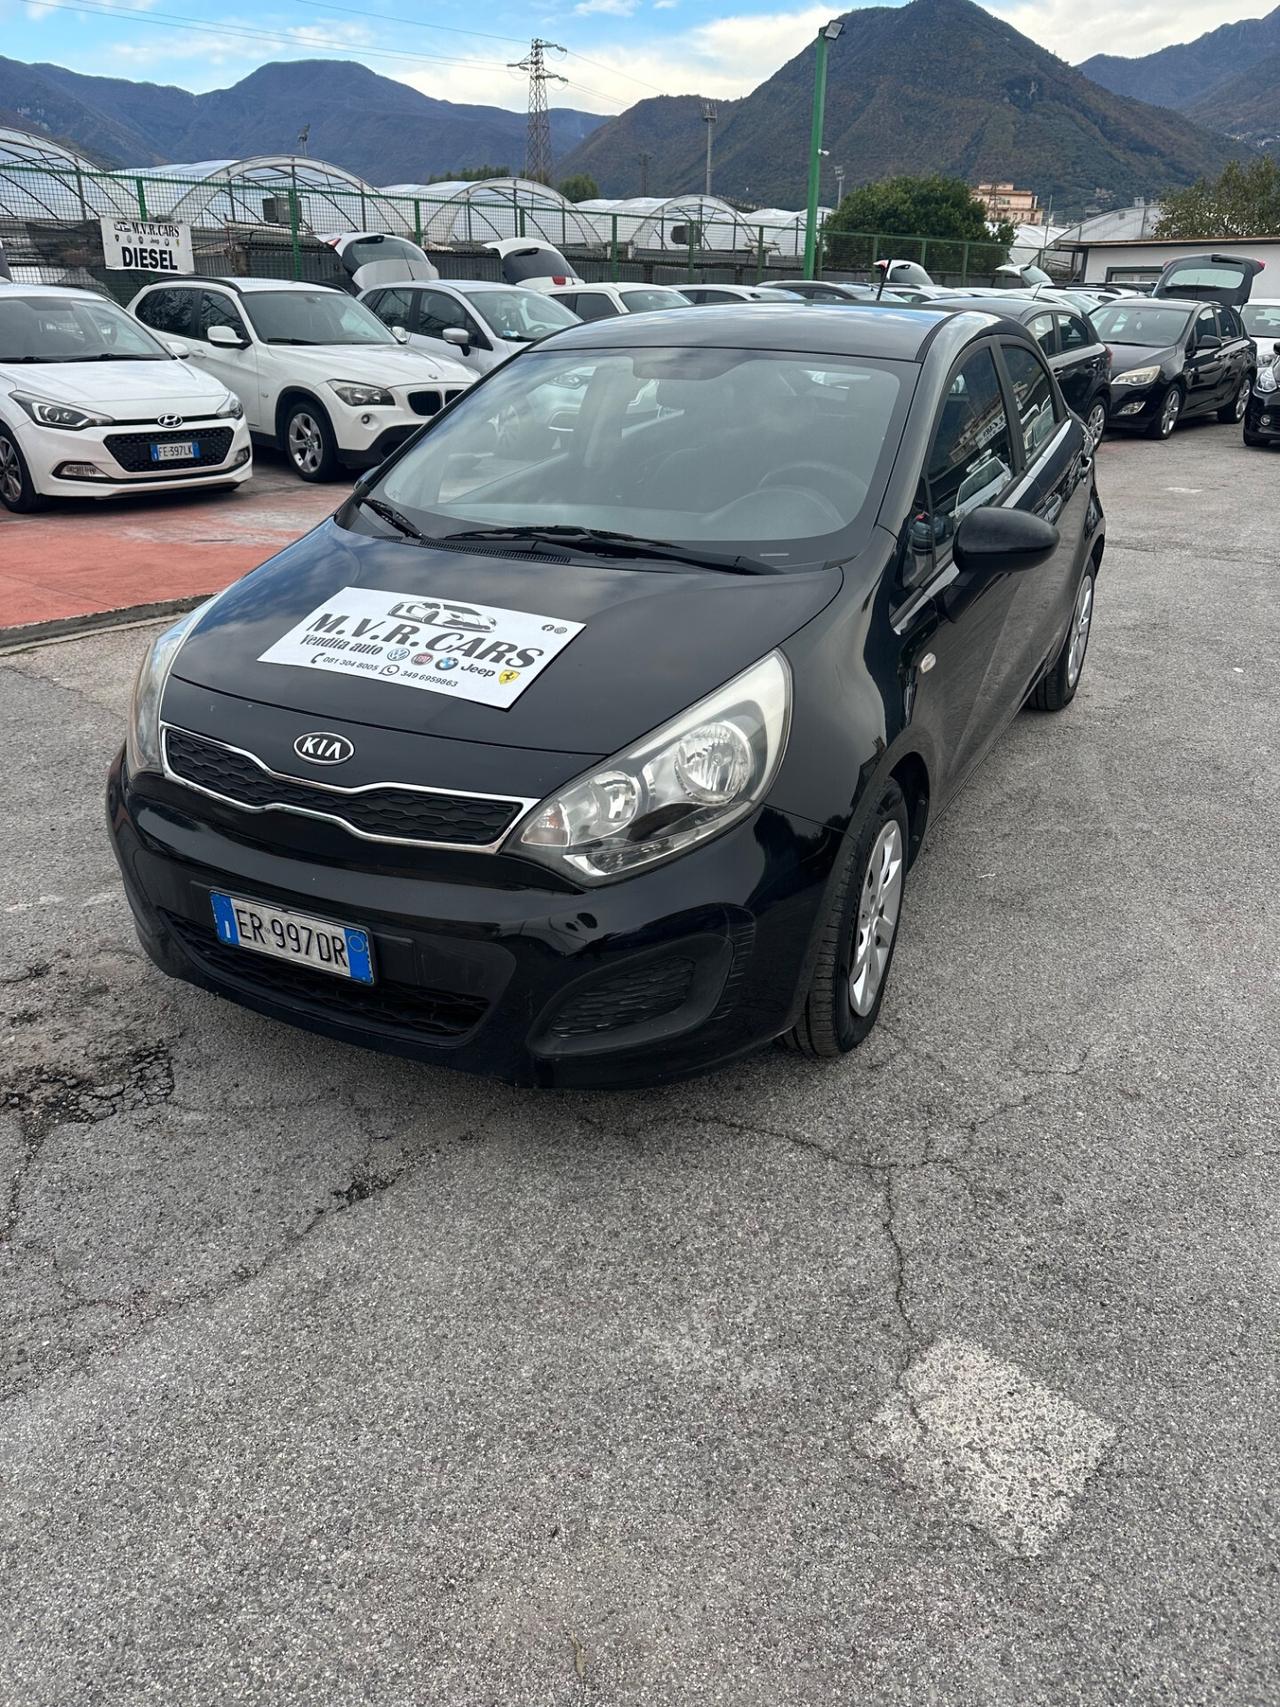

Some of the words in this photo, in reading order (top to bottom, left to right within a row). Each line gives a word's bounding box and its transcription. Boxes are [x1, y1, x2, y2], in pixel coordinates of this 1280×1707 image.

[121, 246, 178, 271] DIESEL
[300, 634, 351, 651] Vendita
[348, 641, 383, 656] auto
[322, 656, 338, 665] 081
[339, 659, 356, 668] 304
[356, 662, 380, 671] 8005
[460, 664, 496, 678] Jeep
[400, 670, 419, 679] 349
[418, 674, 459, 688] 6959863
[301, 736, 342, 760] KIA
